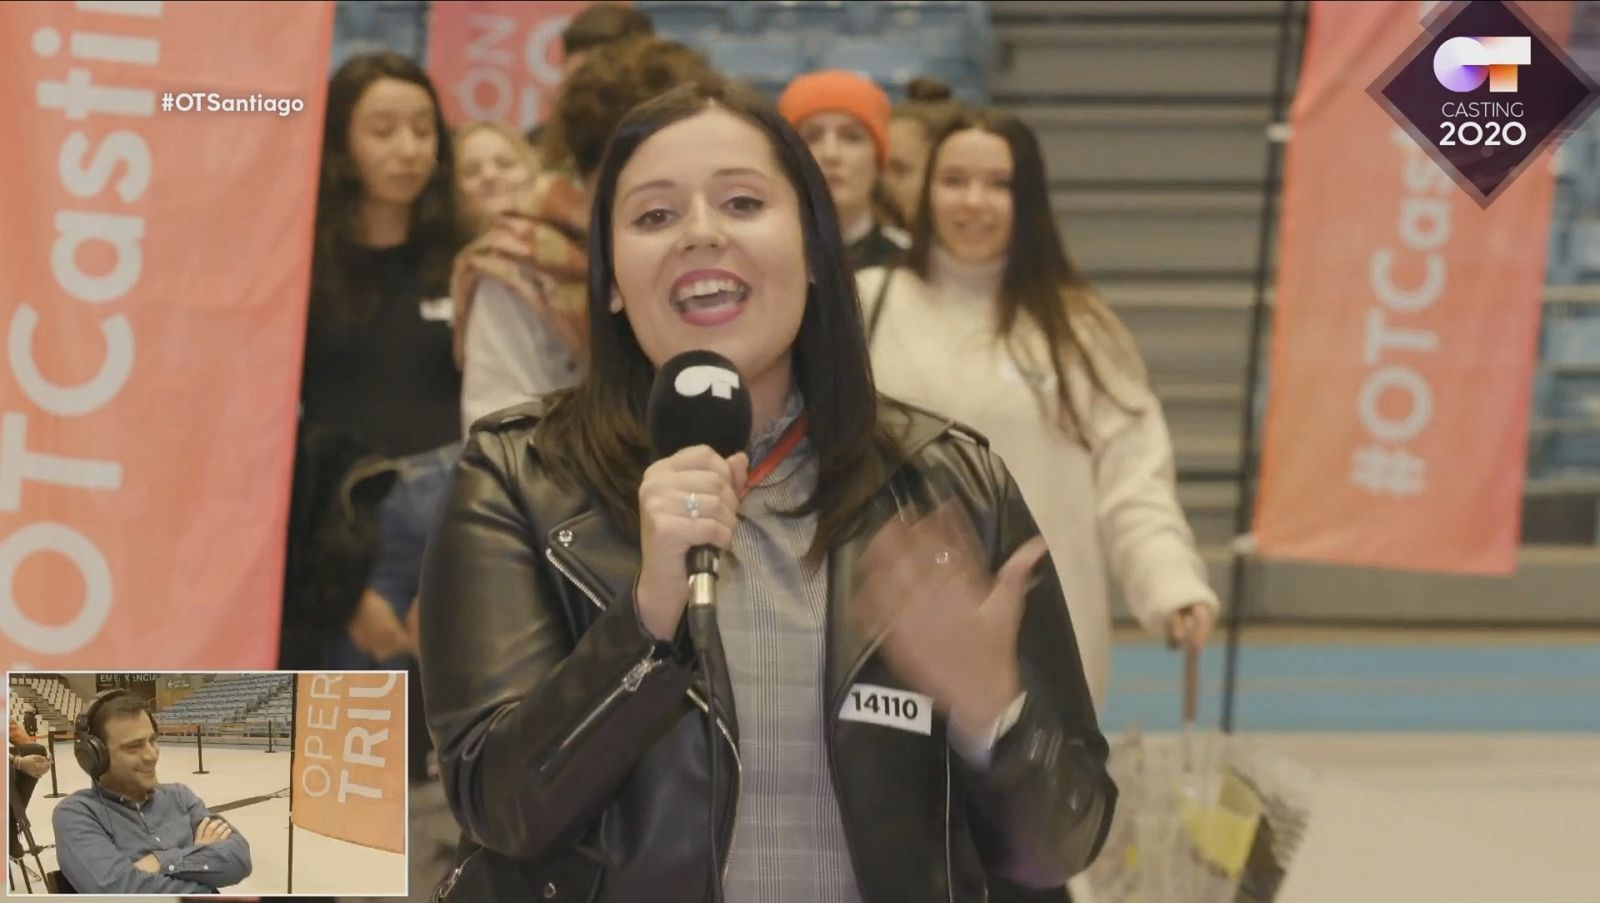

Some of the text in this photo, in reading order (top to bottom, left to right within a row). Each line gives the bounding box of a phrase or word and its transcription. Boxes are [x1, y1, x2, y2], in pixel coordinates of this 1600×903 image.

[0, 1, 162, 667] OTCasti
[302, 673, 344, 798] OPER
[337, 673, 397, 804] TRIU
[851, 691, 919, 720] 14110
